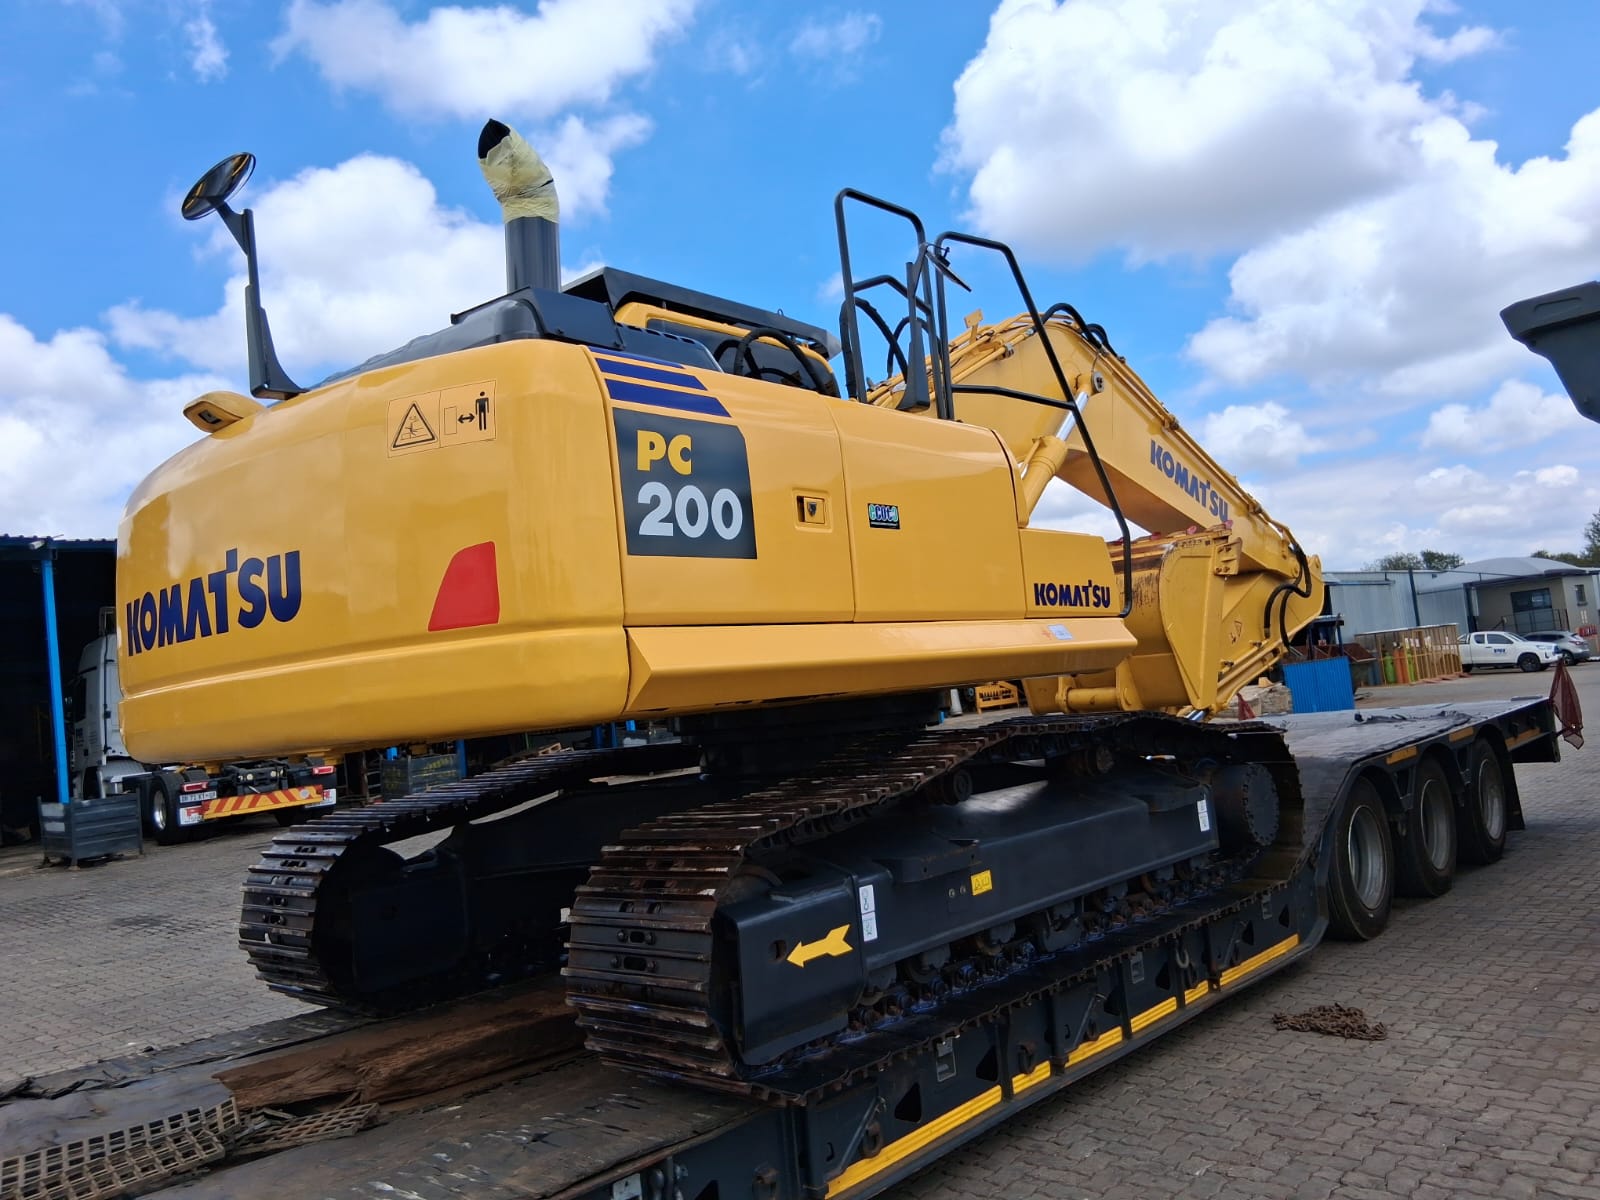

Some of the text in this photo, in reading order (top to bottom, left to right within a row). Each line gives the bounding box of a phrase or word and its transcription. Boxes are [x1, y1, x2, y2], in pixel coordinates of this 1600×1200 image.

[637, 430, 692, 475] PC
[1150, 439, 1229, 523] KOMATSU
[637, 481, 743, 540] 200
[126, 548, 302, 657] KOMATSU
[1033, 579, 1111, 608] KOMATSU
